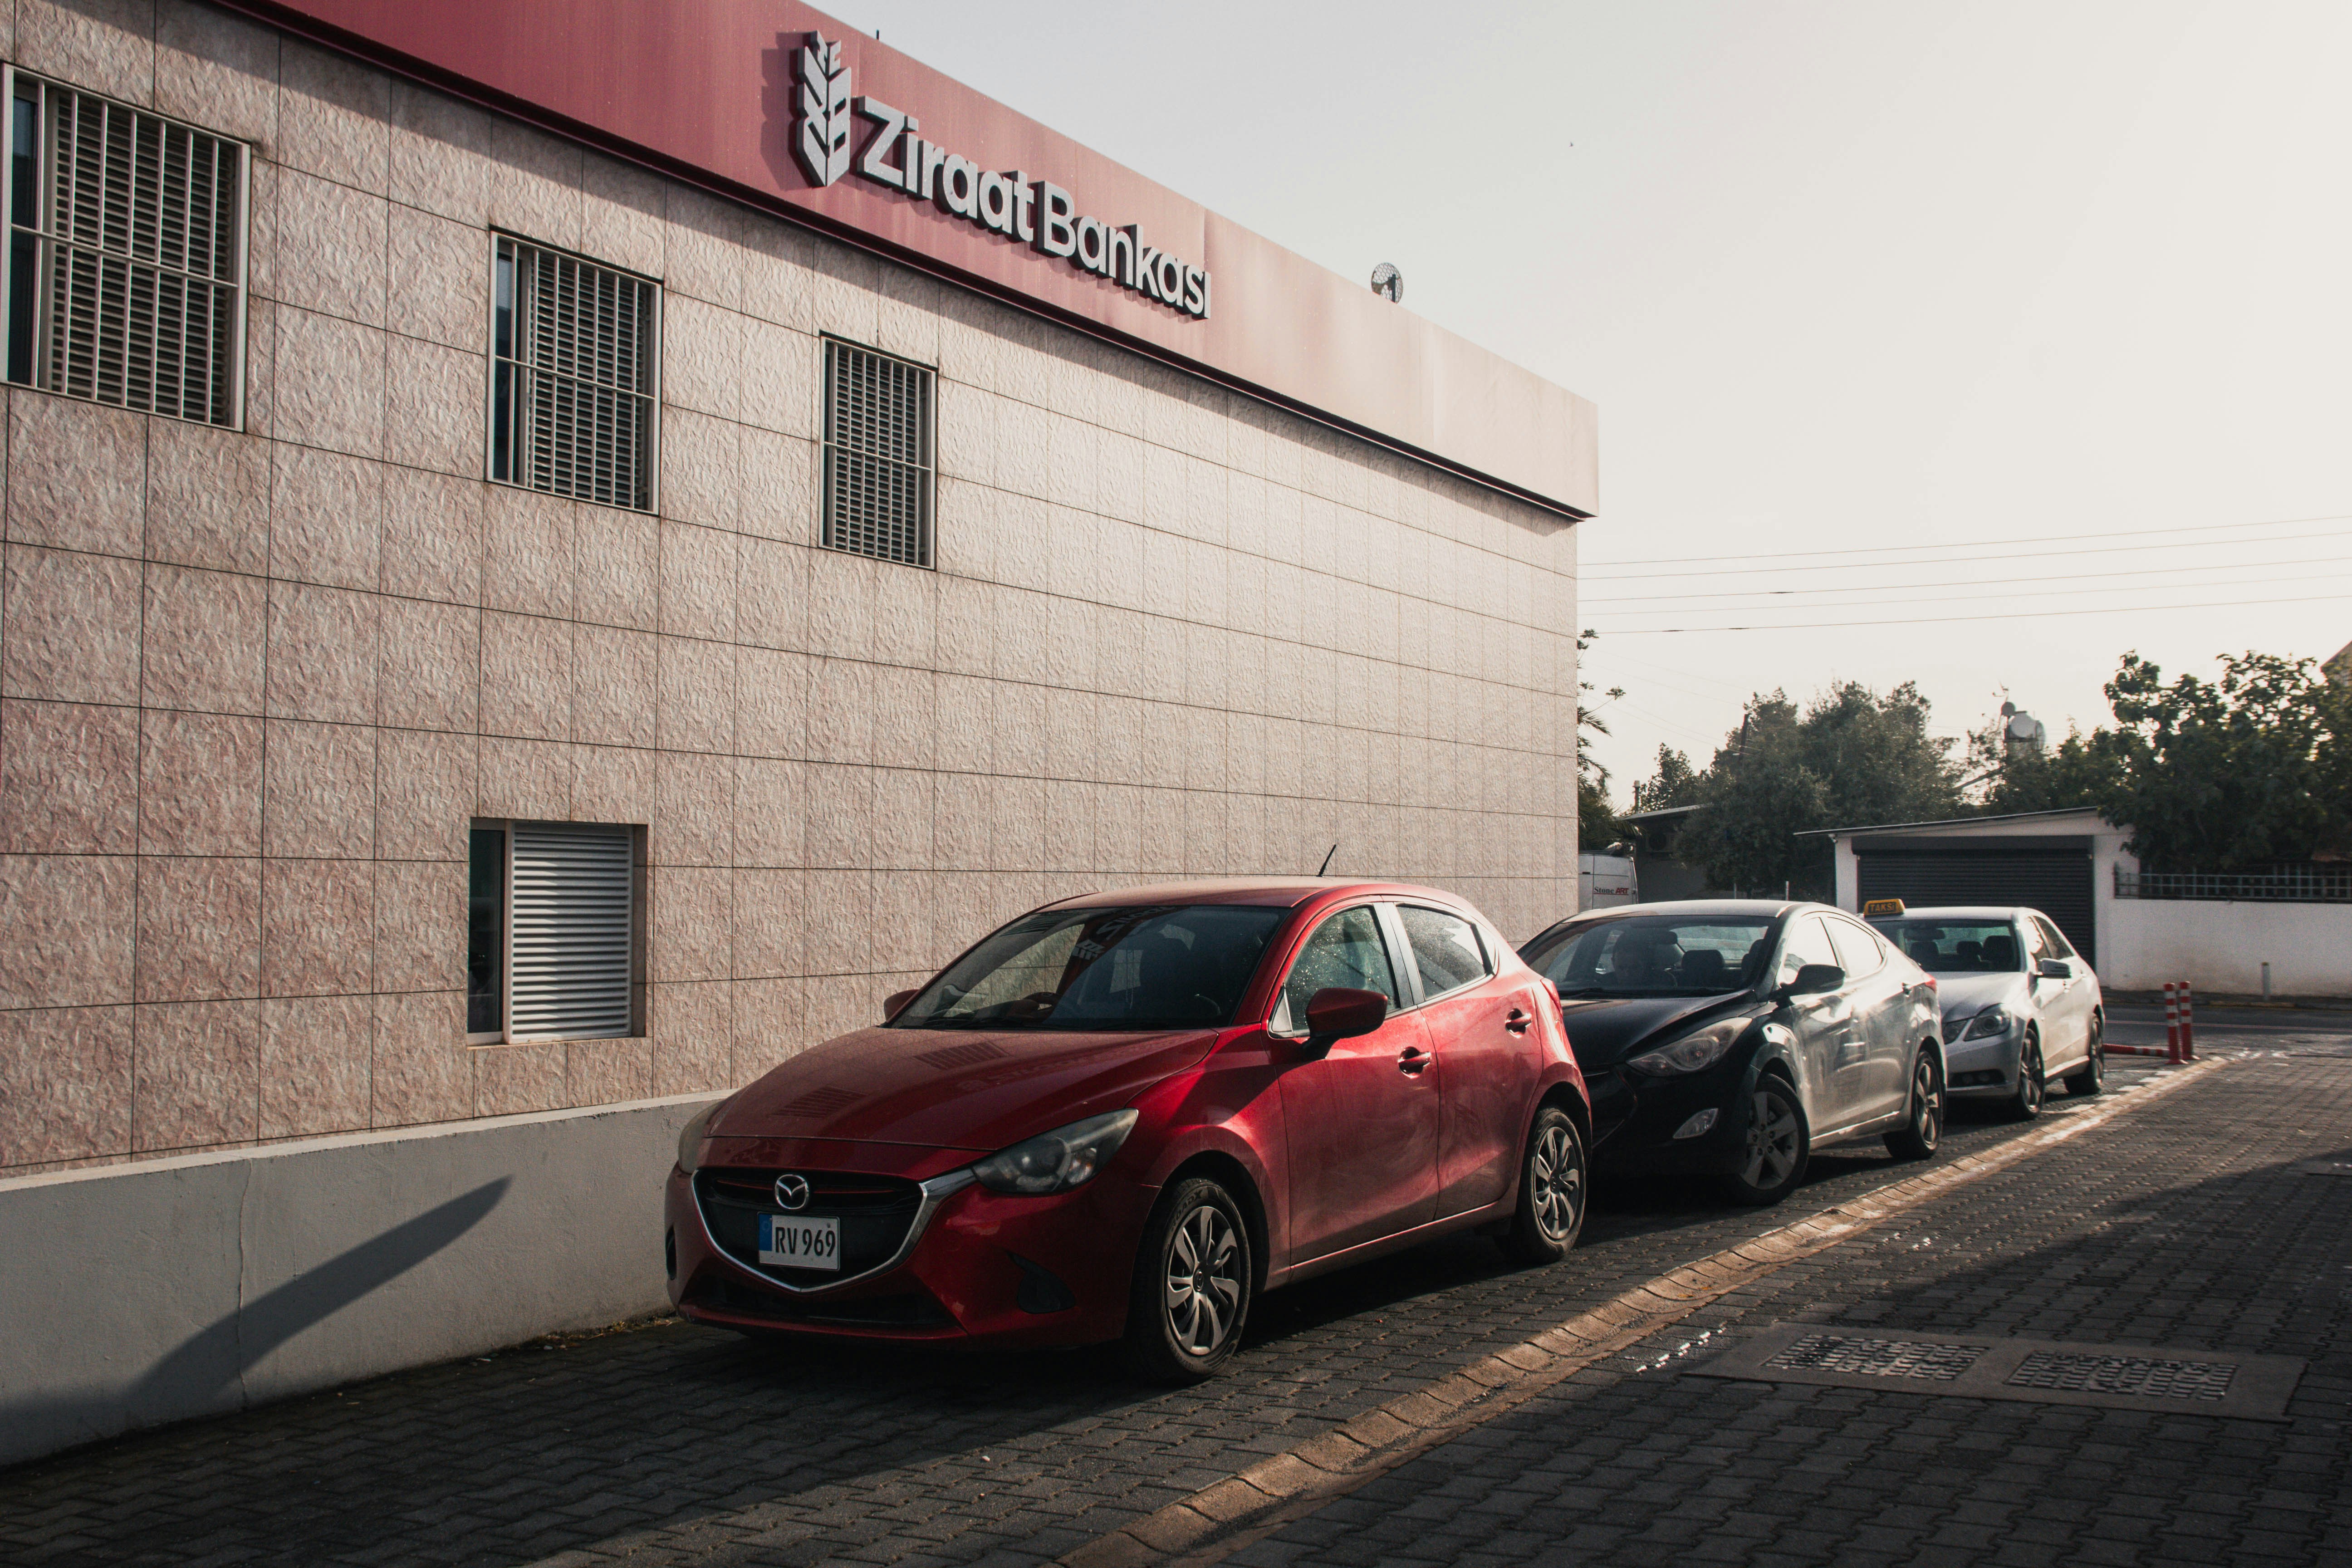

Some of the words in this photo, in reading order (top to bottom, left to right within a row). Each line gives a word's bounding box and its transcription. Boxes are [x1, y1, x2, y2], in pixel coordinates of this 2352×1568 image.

[857, 96, 1034, 242] Ziraat
[775, 1227, 797, 1254] RV
[802, 1229, 836, 1257] 969
